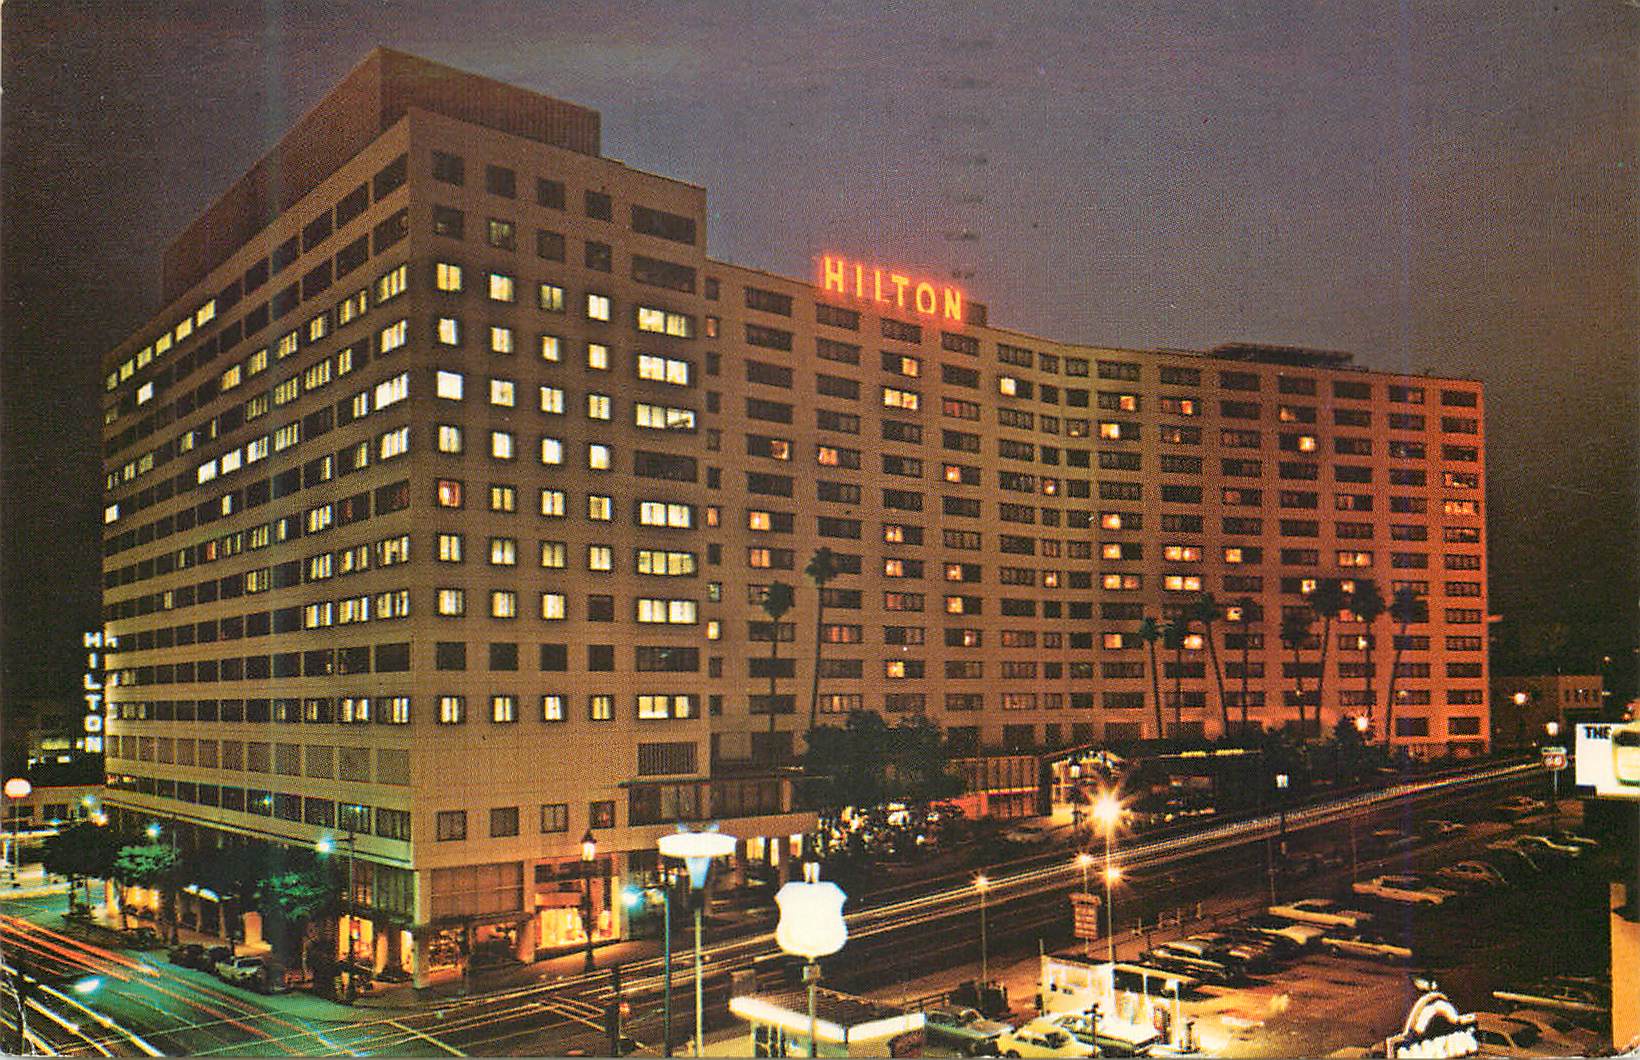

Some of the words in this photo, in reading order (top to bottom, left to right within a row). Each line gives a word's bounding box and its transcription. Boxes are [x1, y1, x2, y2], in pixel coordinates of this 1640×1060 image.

[823, 255, 962, 321] HILTON
[82, 631, 103, 752] HILTON
[1583, 725, 1612, 740] THE
